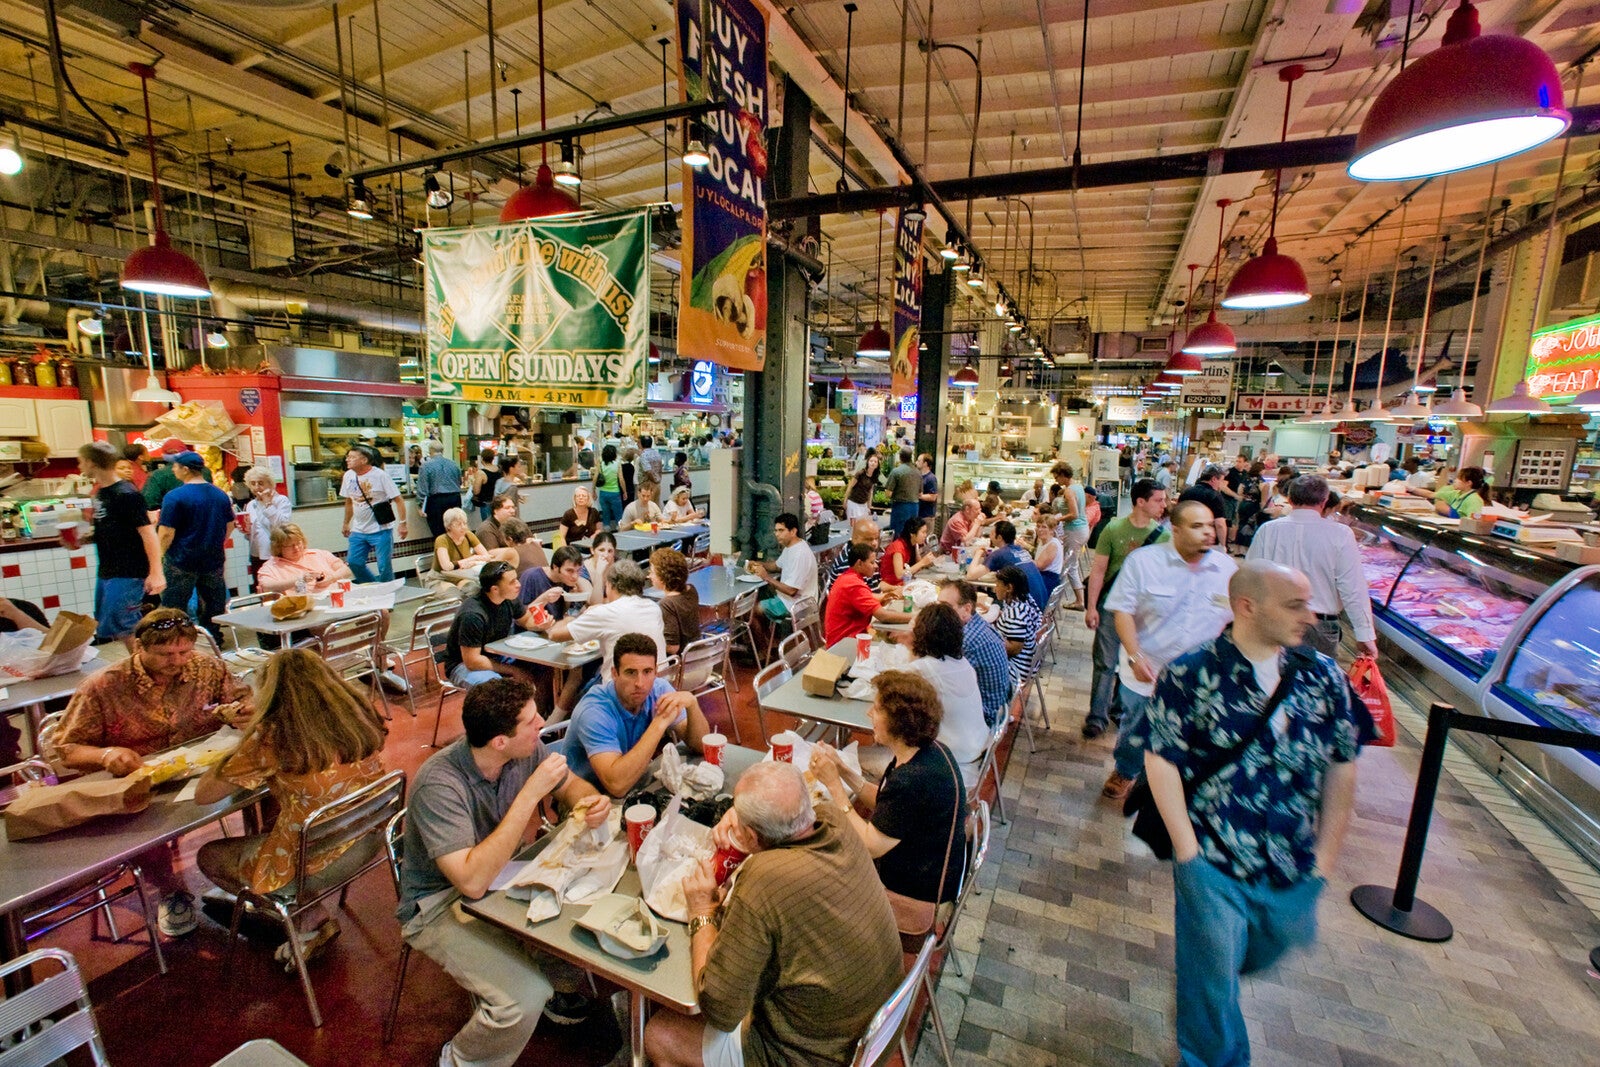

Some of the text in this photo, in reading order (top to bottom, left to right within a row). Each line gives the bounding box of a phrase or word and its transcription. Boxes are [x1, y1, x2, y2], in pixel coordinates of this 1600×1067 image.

[709, 0, 748, 63] UY
[694, 143, 766, 209] OCAL
[559, 245, 606, 292] with
[441, 353, 501, 380] OPEN
[1552, 369, 1593, 392] EAT
[484, 388, 521, 400] 9AM
[544, 392, 583, 403] 4PM
